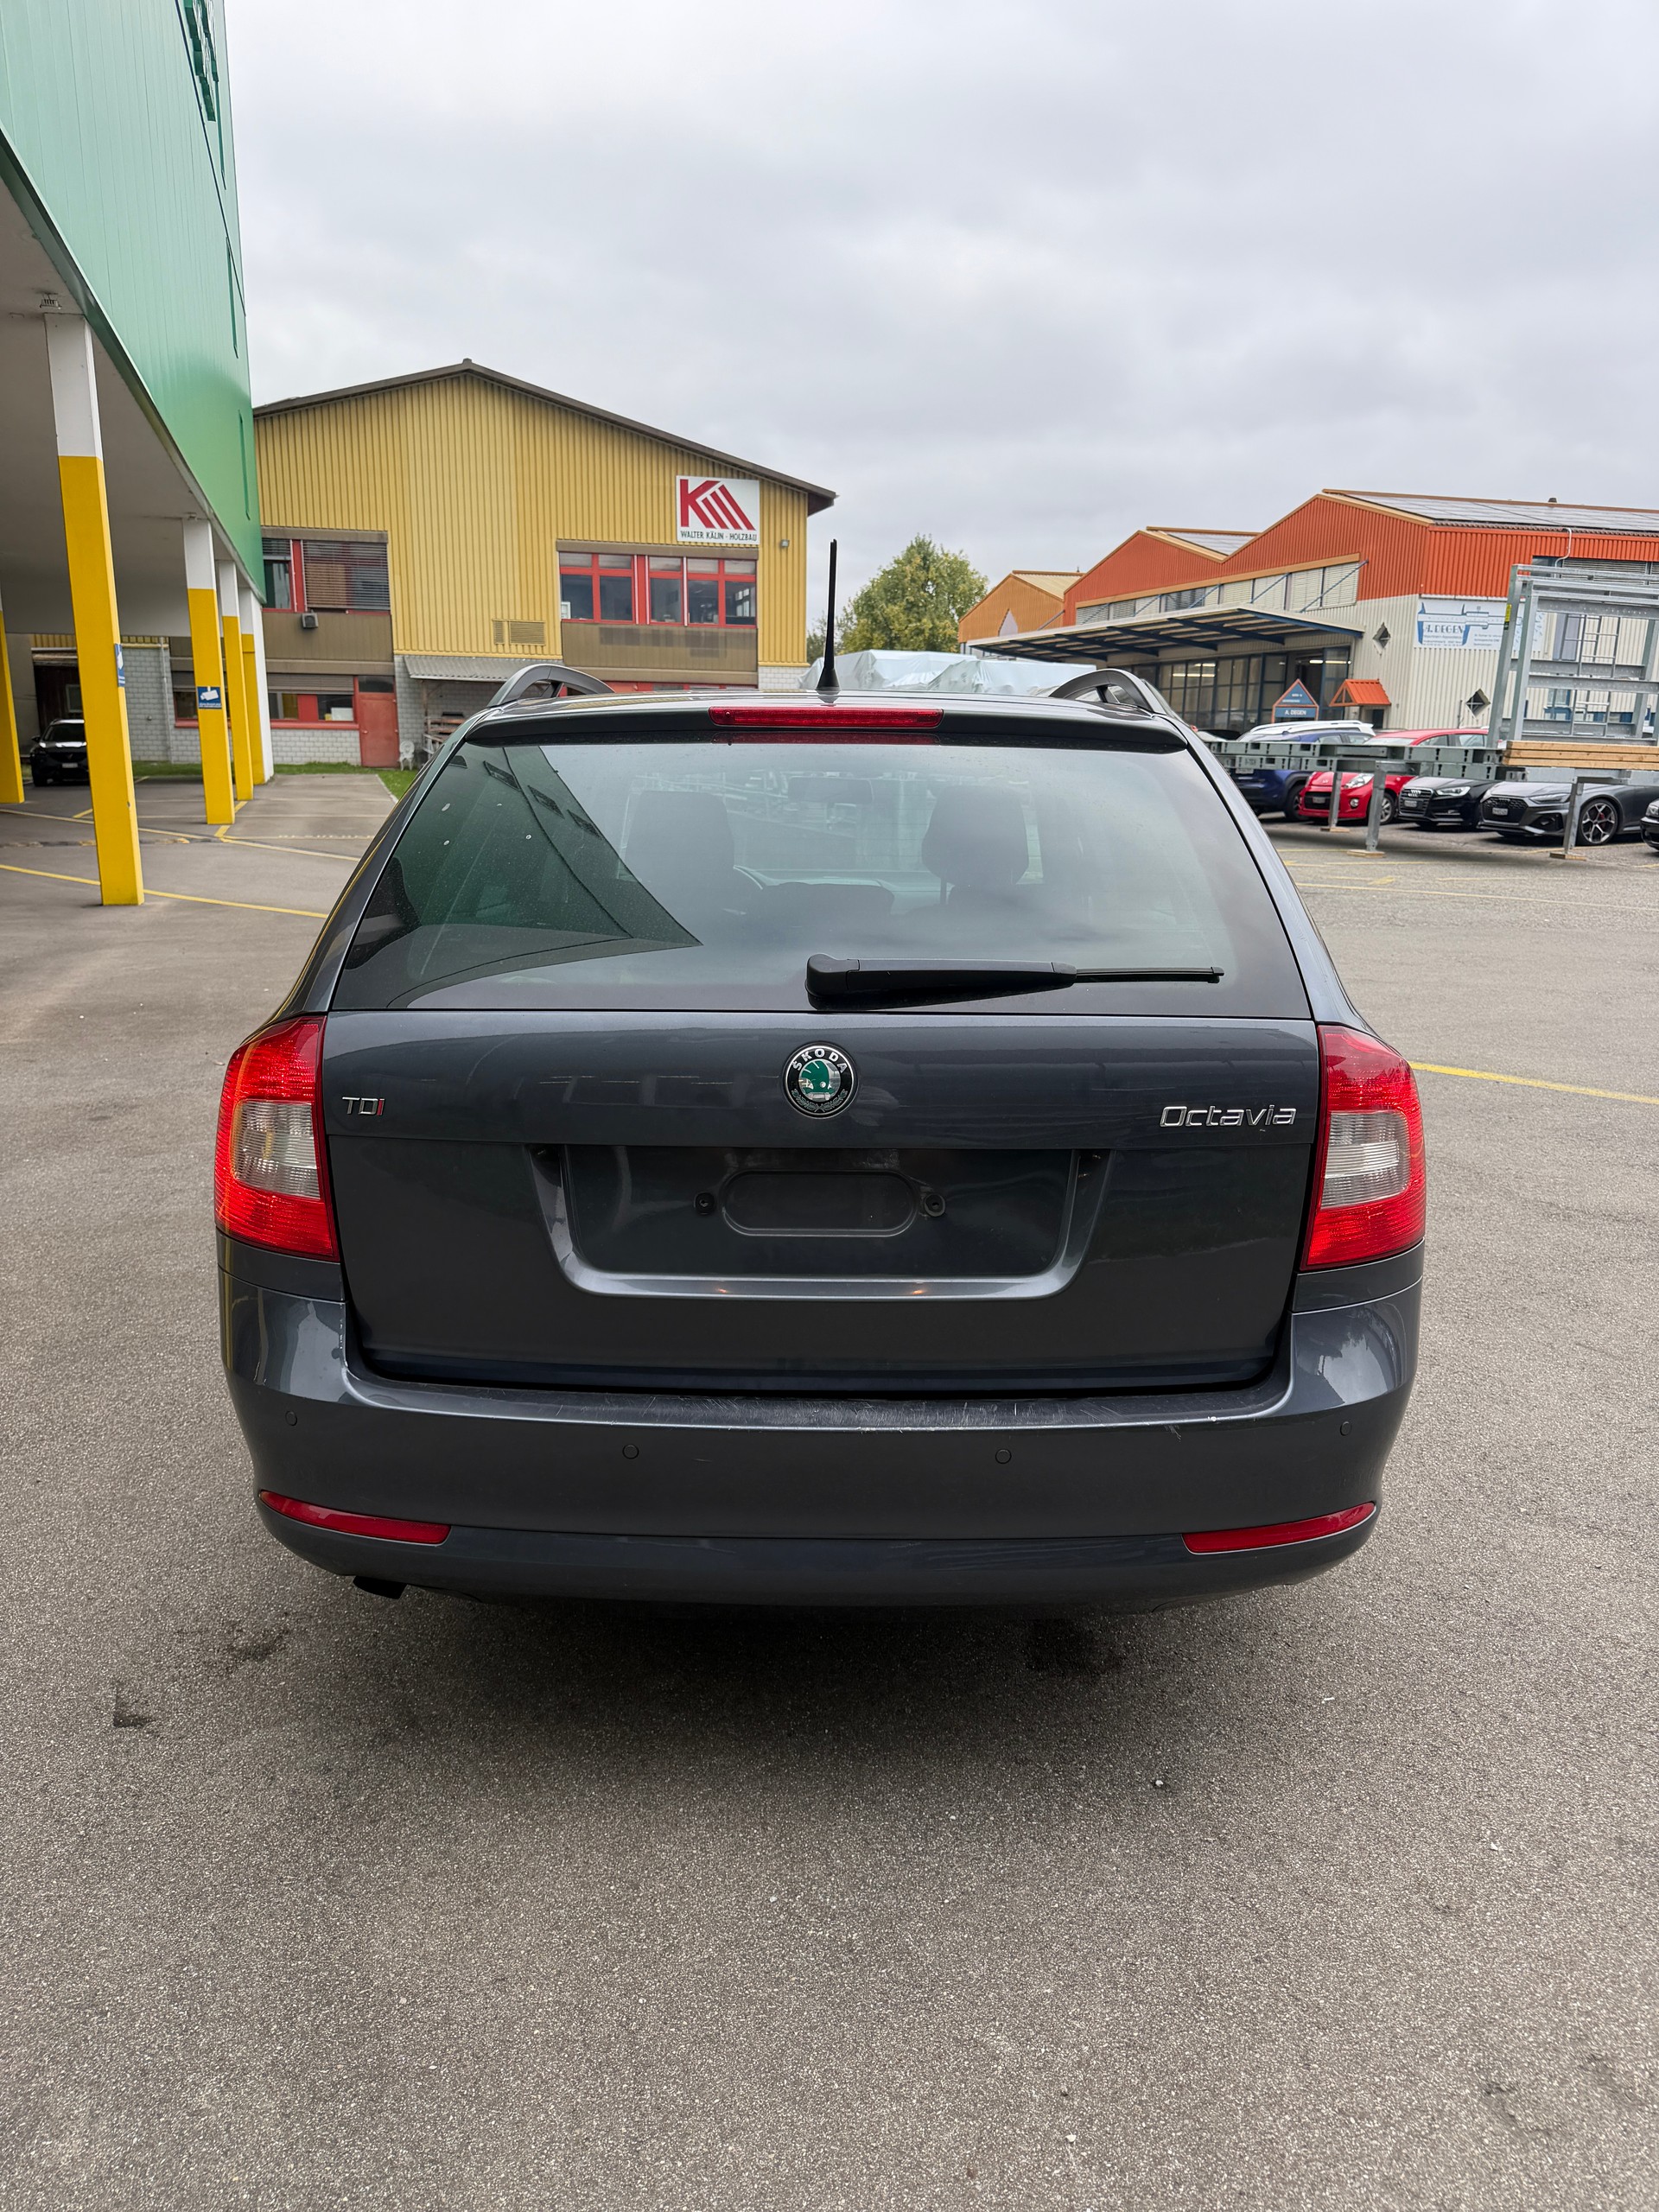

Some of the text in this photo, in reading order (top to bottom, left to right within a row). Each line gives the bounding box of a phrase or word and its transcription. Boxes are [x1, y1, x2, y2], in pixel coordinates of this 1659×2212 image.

[680, 531, 703, 539] WALTER
[706, 531, 724, 539] KÄLIN
[729, 532, 757, 541] HOLZBAU
[1434, 625, 1464, 633] DEGEN
[1160, 1104, 1296, 1127] Octavia
